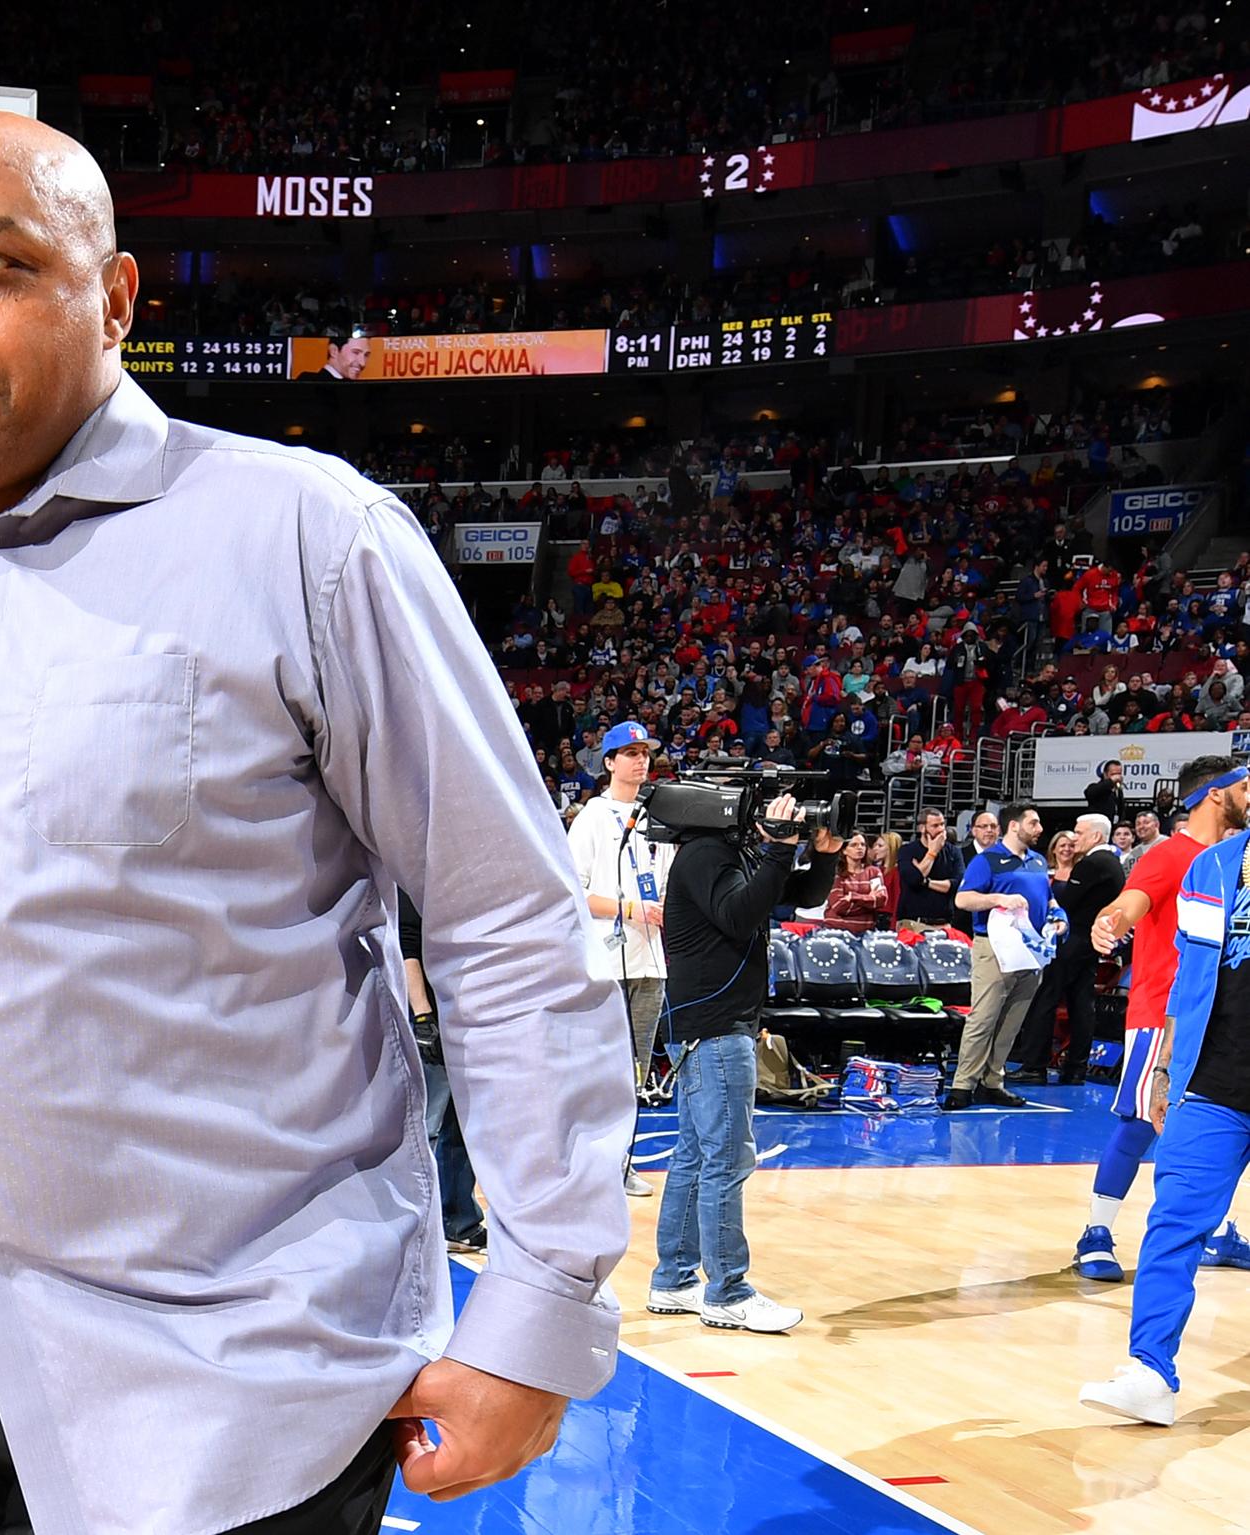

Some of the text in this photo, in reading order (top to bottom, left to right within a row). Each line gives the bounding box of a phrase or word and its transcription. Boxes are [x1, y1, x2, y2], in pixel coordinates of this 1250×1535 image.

[725, 154, 749, 190] 2
[257, 176, 373, 216] MOSES
[721, 312, 833, 332] REB AST BLK STL
[382, 337, 400, 350] THE
[435, 335, 452, 349] THE
[493, 333, 511, 347] THE
[614, 334, 662, 353] 8:11
[680, 324, 826, 351] PHI 24 13 2 2
[120, 342, 283, 355] PLAYER 5 24 15 25 27
[676, 341, 826, 368] DEN 22 19 2 4
[121, 361, 283, 374] POINTS 12 2 14 10 11
[382, 350, 439, 377] HUGH
[627, 356, 649, 368] PM
[1124, 491, 1203, 511] GEICO
[1113, 514, 1146, 533] 105
[464, 529, 529, 542] GEICO
[457, 547, 483, 561] 106
[508, 546, 536, 560] 105
[1123, 781, 1147, 790] xtra
[724, 806, 733, 816] 14
